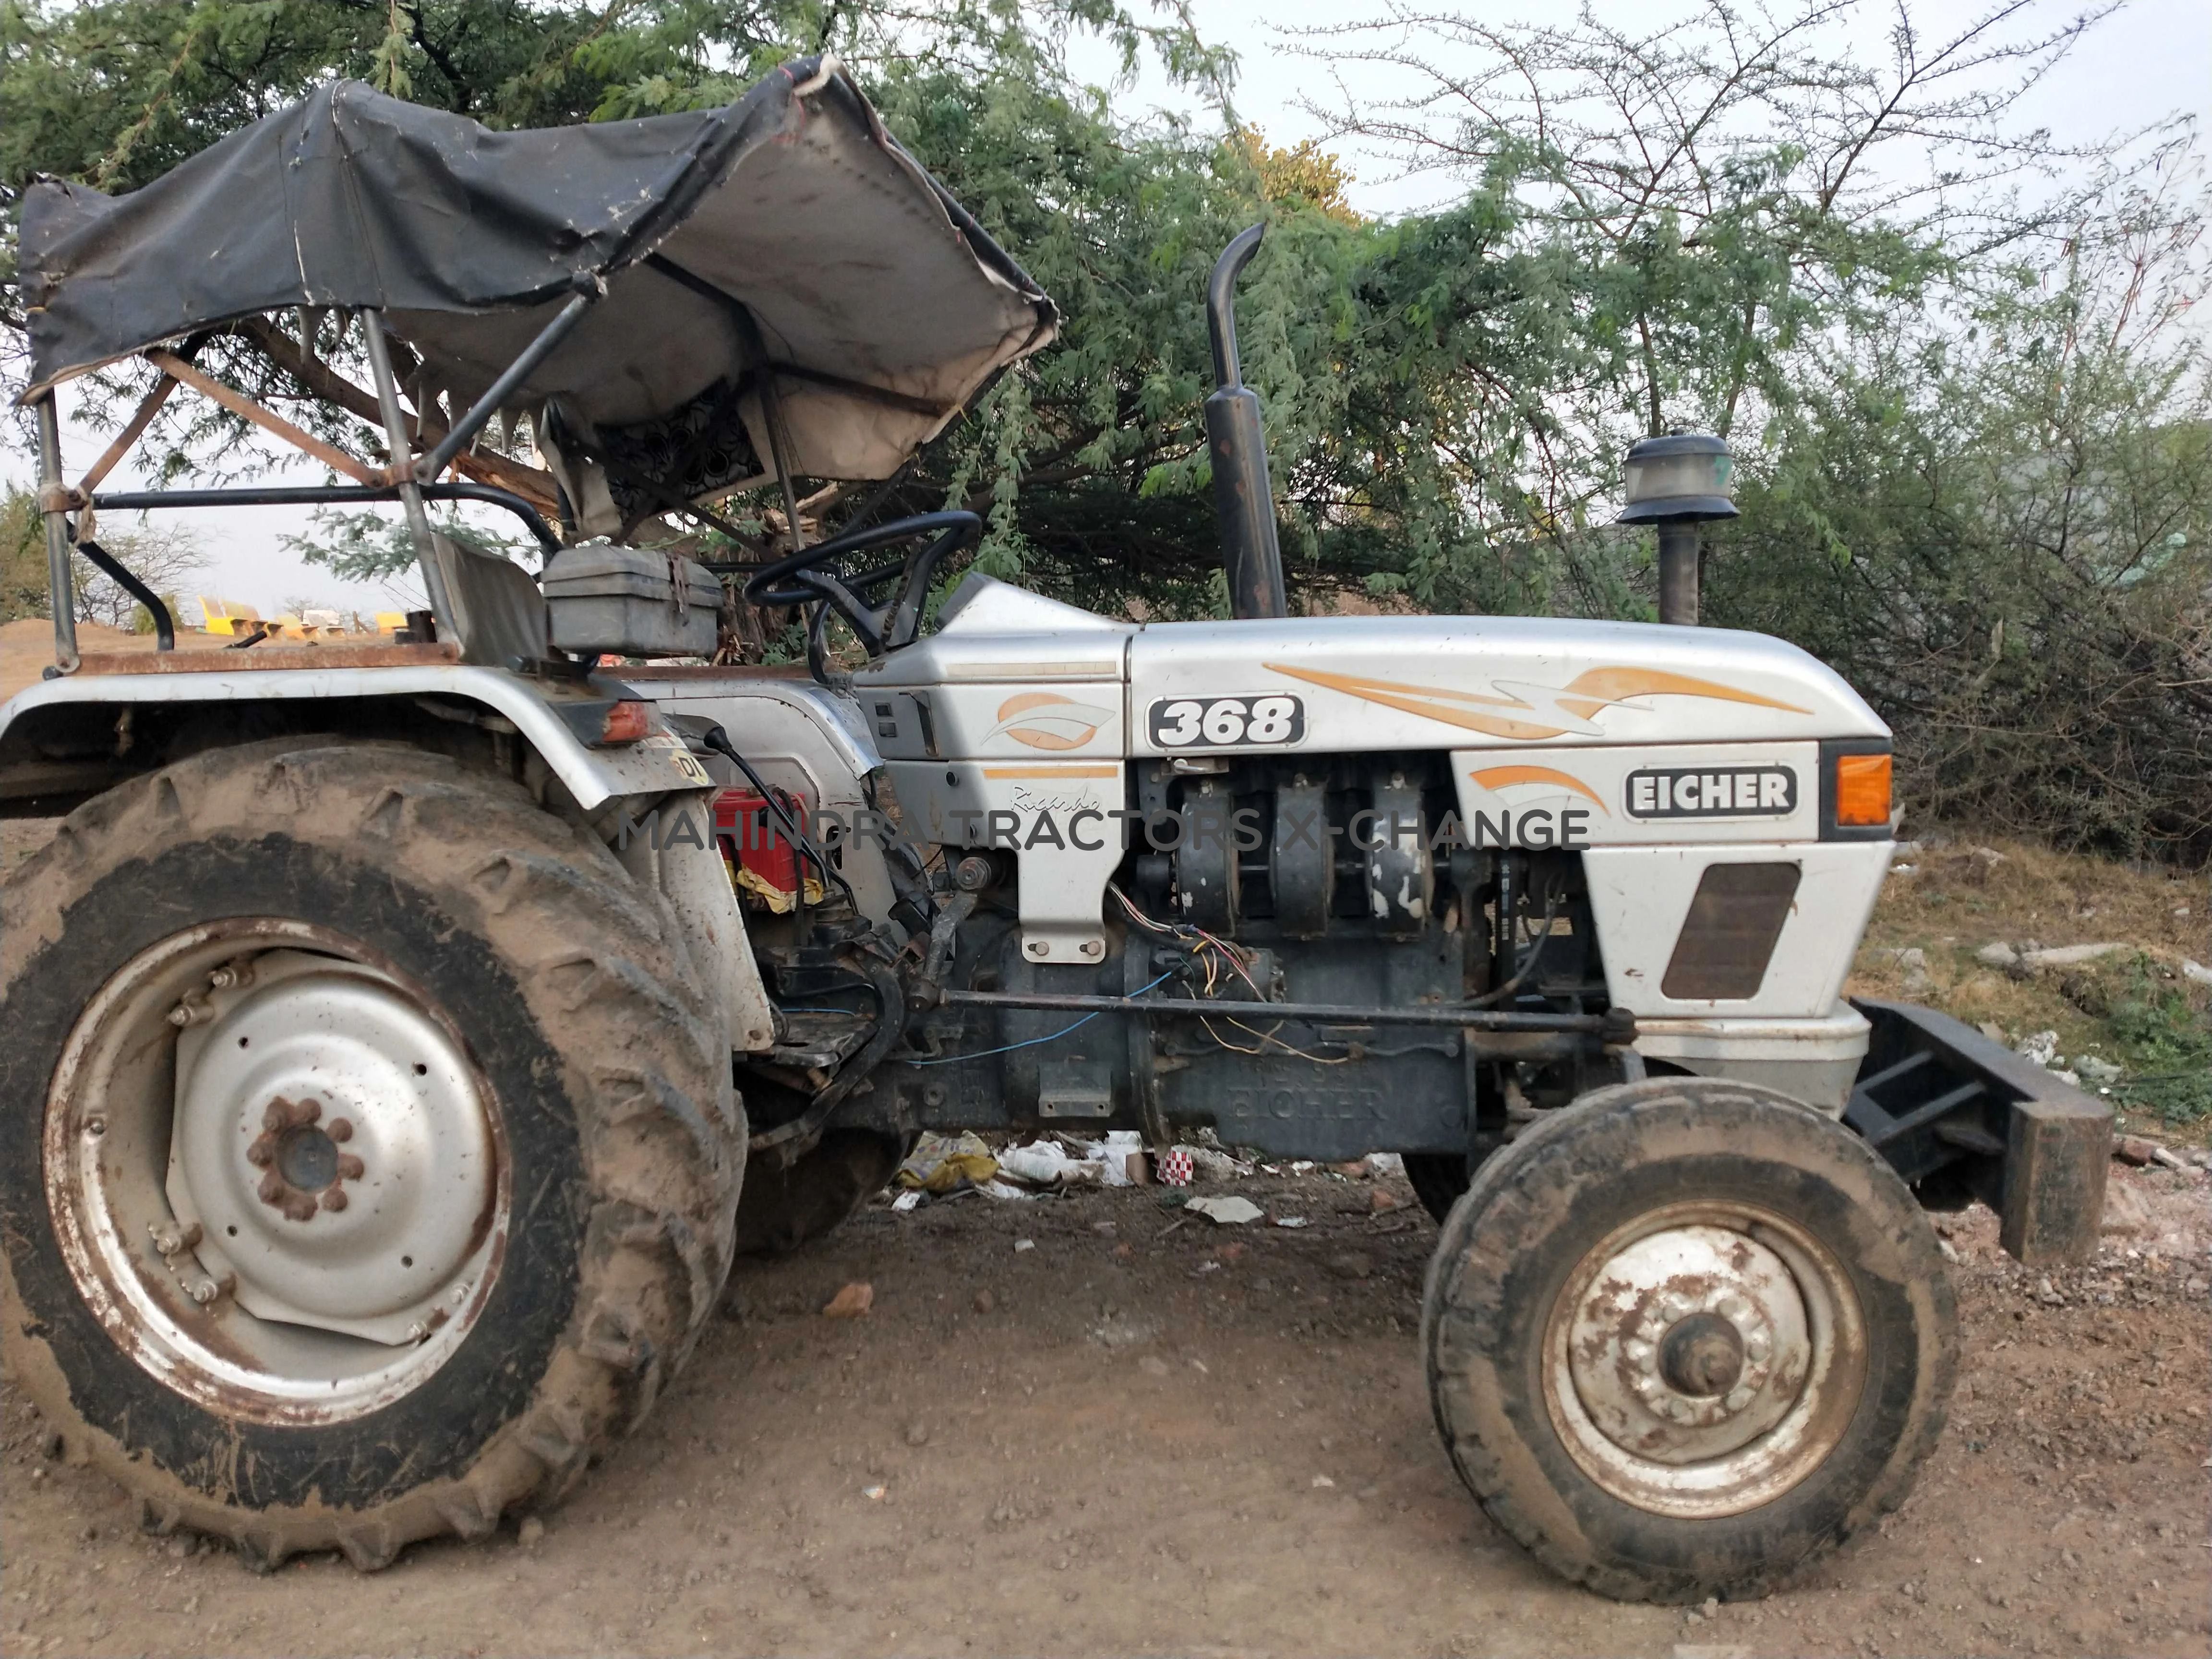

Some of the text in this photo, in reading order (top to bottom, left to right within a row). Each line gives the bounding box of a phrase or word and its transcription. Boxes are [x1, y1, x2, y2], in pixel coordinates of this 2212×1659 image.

[1158, 698, 1294, 745] 368
[1010, 786, 1100, 812] Ricardo
[1633, 773, 1789, 811] EICHER
